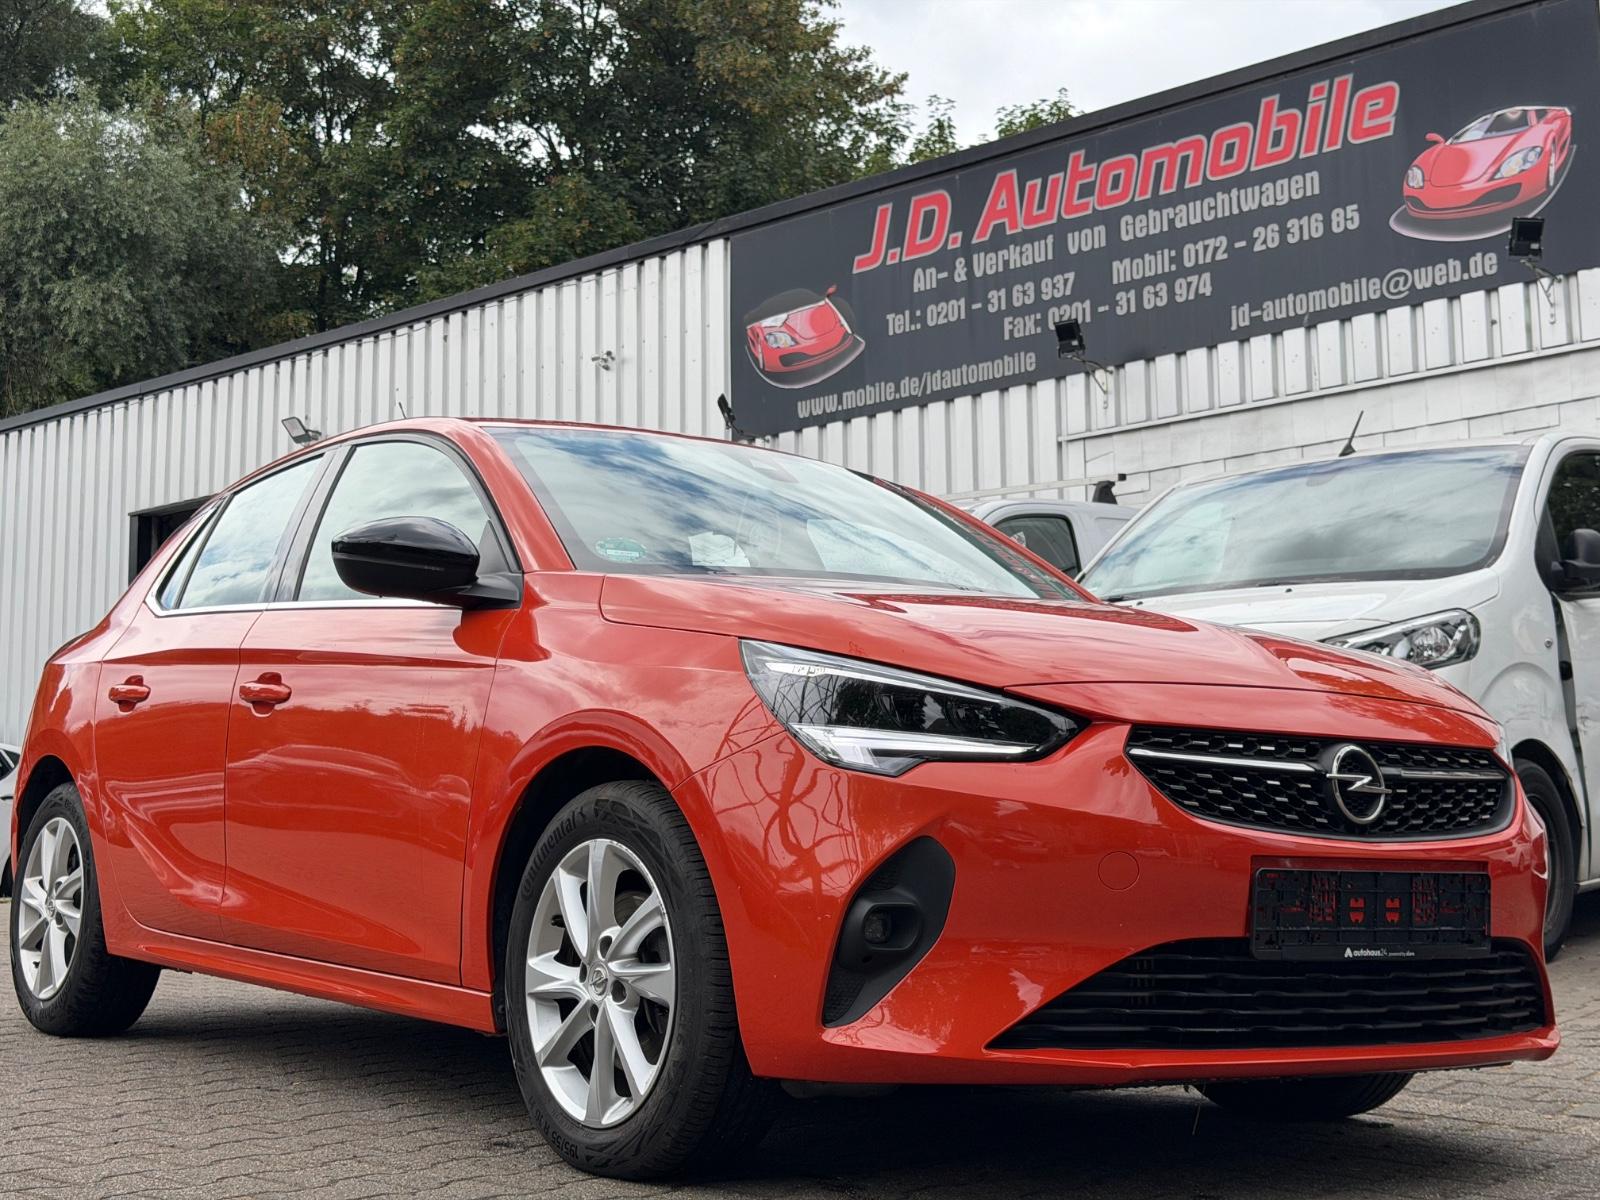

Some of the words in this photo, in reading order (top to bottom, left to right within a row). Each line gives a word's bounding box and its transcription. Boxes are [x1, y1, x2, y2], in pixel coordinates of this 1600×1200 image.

[853, 190, 962, 274] J.D.
[972, 74, 1400, 244] Automobile
[913, 268, 949, 293] An-
[953, 257, 968, 283] &
[972, 235, 1054, 278] Verkauf
[1067, 225, 1106, 255] von
[1120, 171, 1320, 241] Gebrauchtwagen
[1112, 248, 1176, 285] Mobil:
[1183, 236, 1228, 268] 0172
[1253, 224, 1280, 252] 26
[1286, 213, 1323, 243] 316
[1331, 203, 1360, 234] 85
[886, 309, 921, 336] Tel.:
[927, 298, 965, 327] 0201
[988, 288, 1007, 313] 31
[1013, 281, 1035, 308] 63
[1041, 271, 1075, 301] 937
[1004, 312, 1041, 341] Fax:
[1048, 299, 1091, 331] 0201
[1116, 290, 1135, 316] 31
[1142, 282, 1168, 310] 63
[1174, 271, 1212, 303] 974
[1230, 252, 1498, 331] jd-automobile@web.de
[797, 352, 1036, 419] www.mobile.de/jdautomobile
[521, 810, 578, 898] Continental
[550, 1130, 579, 1160] 195/55
